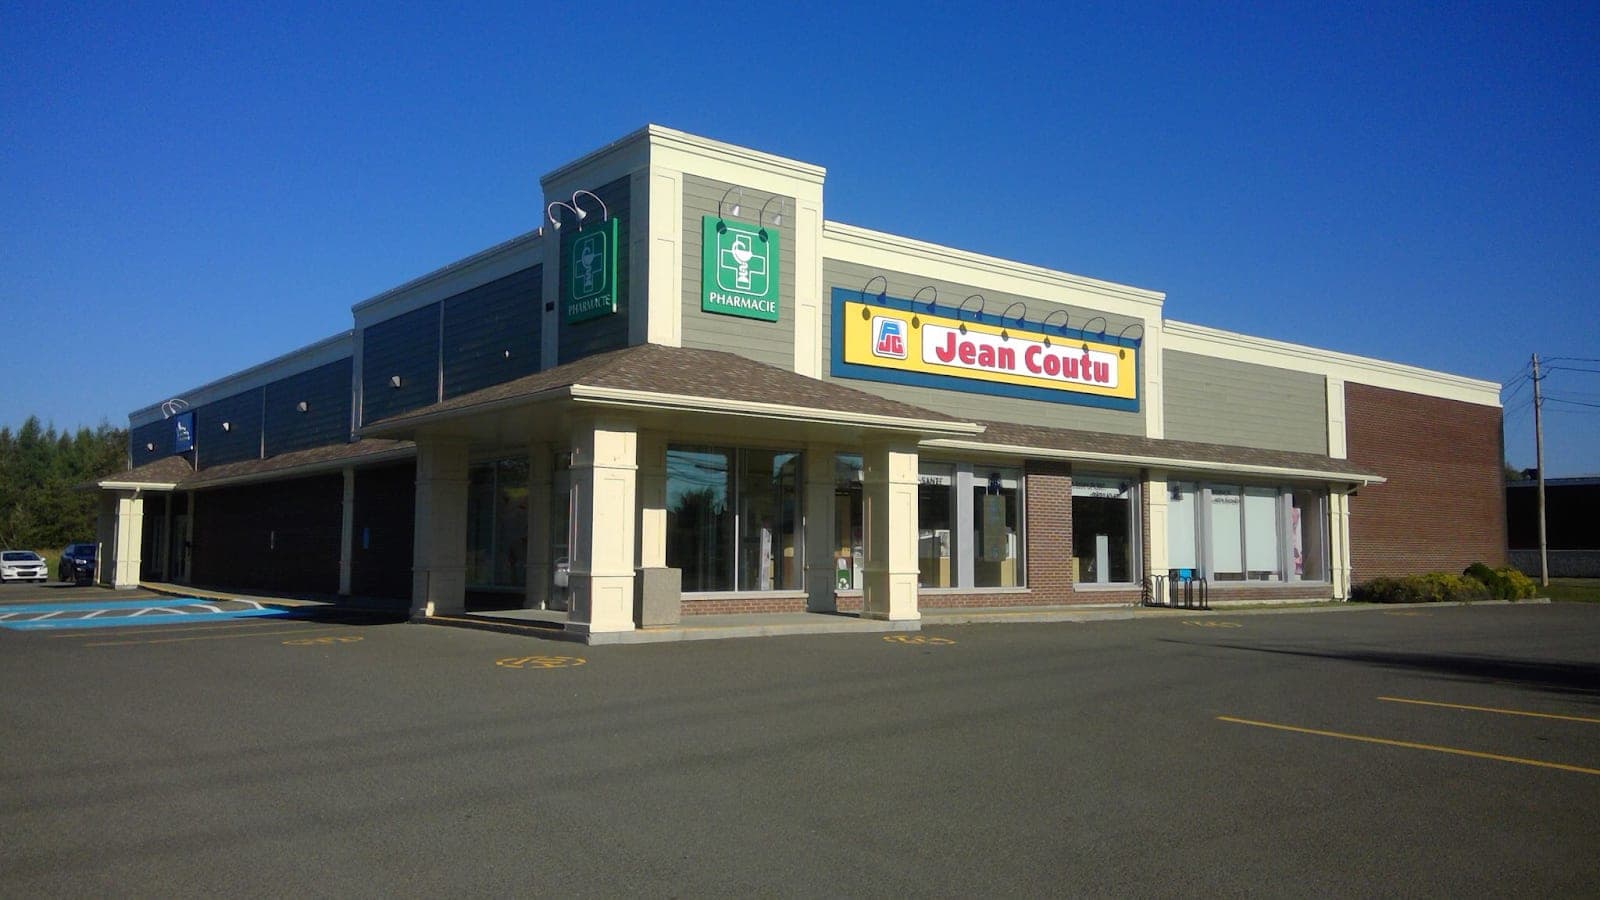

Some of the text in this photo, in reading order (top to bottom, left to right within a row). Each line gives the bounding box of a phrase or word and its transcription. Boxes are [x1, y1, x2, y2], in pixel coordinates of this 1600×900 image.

[709, 292, 776, 313] PHARMACIE
[936, 332, 1110, 383] Jean Coutu
